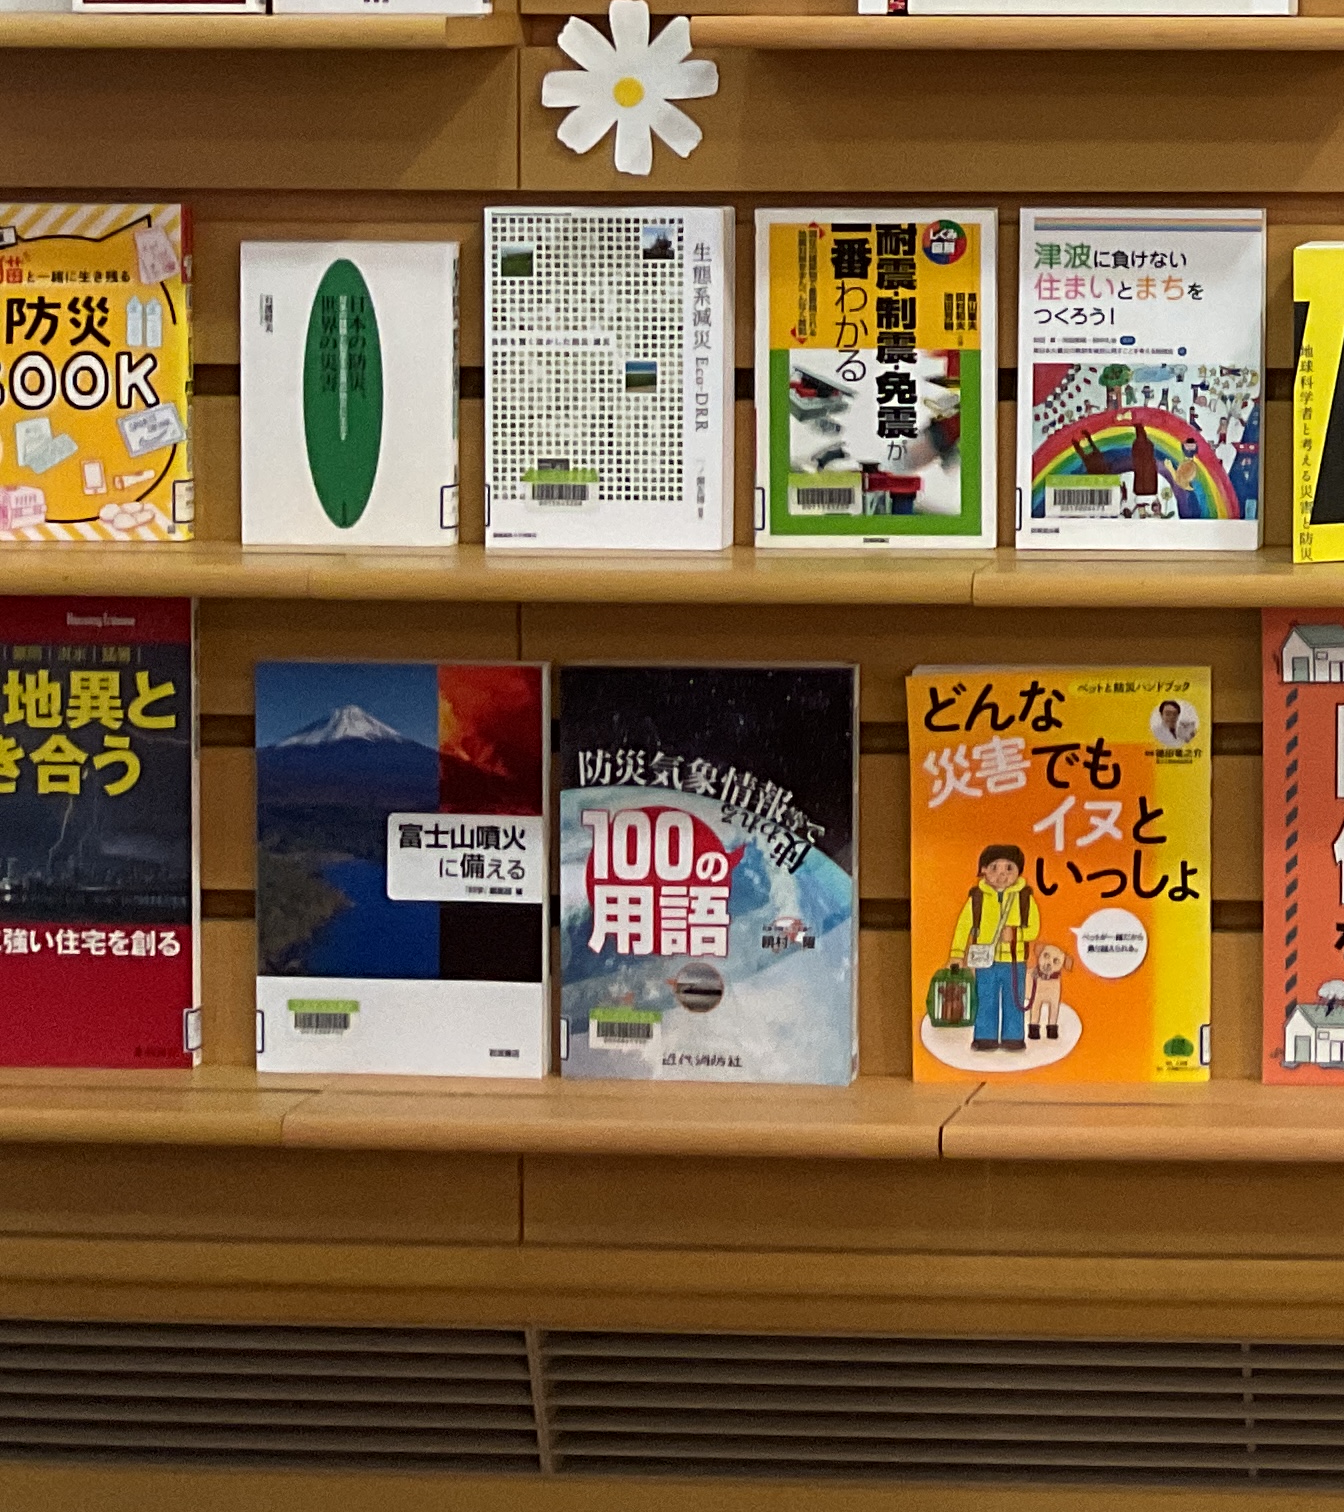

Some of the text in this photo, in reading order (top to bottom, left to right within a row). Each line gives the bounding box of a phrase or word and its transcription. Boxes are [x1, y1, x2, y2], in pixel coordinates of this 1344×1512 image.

[1034, 243, 1187, 269] 津波に負けない
[830, 223, 869, 383] 一番わかる
[1034, 274, 1204, 301] 住まいとまちを
[6, 296, 111, 346] 防災
[875, 223, 918, 462] 耐震・制震・免震が
[0, 351, 160, 410] OOK
[1299, 344, 1314, 561] 地球科学者と考える災害と防災
[3, 670, 176, 730] 地異と
[923, 681, 1065, 732] どんな
[923, 735, 1122, 808] 災害でも
[398, 824, 526, 851] 富士山噴火
[582, 809, 729, 882] 100の
[1032, 796, 1168, 852] イヌと
[440, 854, 526, 880] に備える
[1035, 850, 1200, 902] いっしょ
[588, 885, 729, 957] 用語
